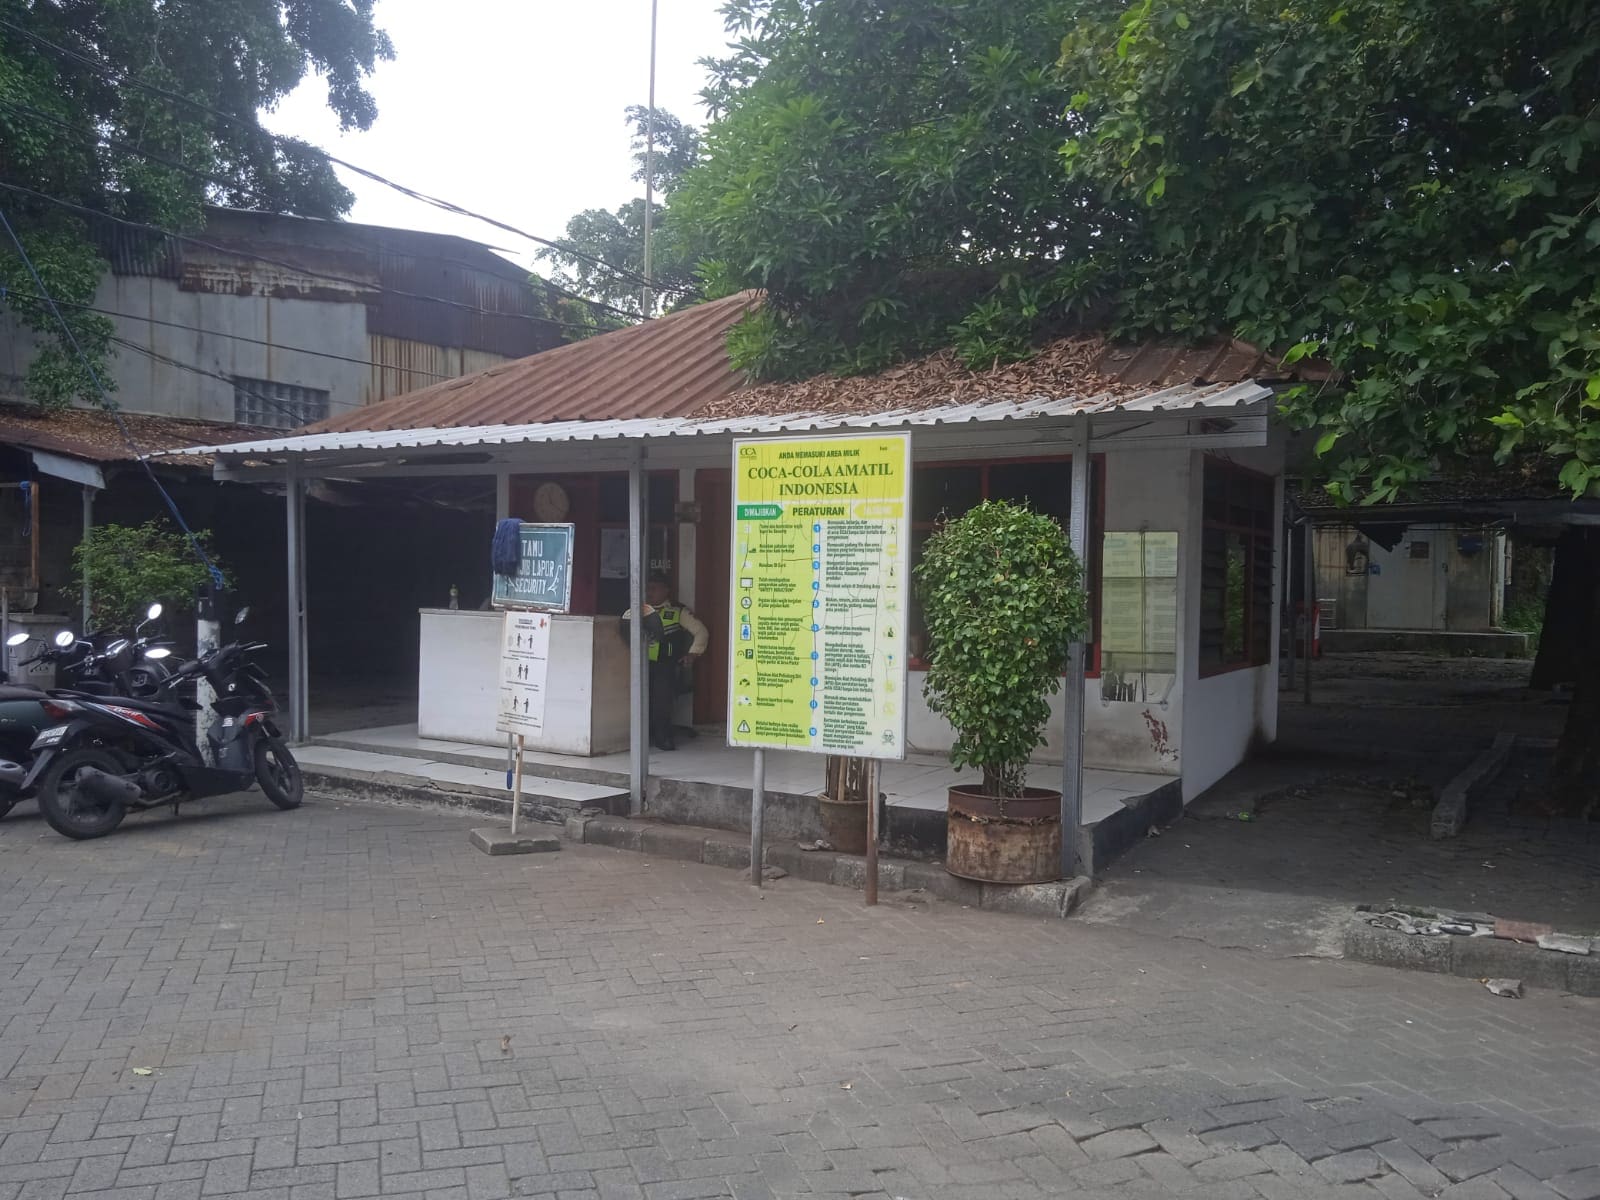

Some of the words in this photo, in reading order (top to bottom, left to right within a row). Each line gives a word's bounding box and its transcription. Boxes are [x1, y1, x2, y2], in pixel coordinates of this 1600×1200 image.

[740, 447, 757, 456] CCA
[778, 452, 794, 460] ANDA
[795, 450, 826, 459] MEMASUKI
[826, 450, 842, 458] AREA
[843, 449, 860, 457] MILIK
[748, 464, 832, 480] COCA-COLA
[835, 463, 894, 477] AMATIL
[779, 482, 858, 496] INDONESIA
[744, 508, 777, 517] DIWAJIBKAN
[792, 506, 844, 516] PERATURAN
[522, 540, 543, 557] TAMU
[532, 560, 555, 577] LAPOR
[515, 578, 547, 594] SECURITY
